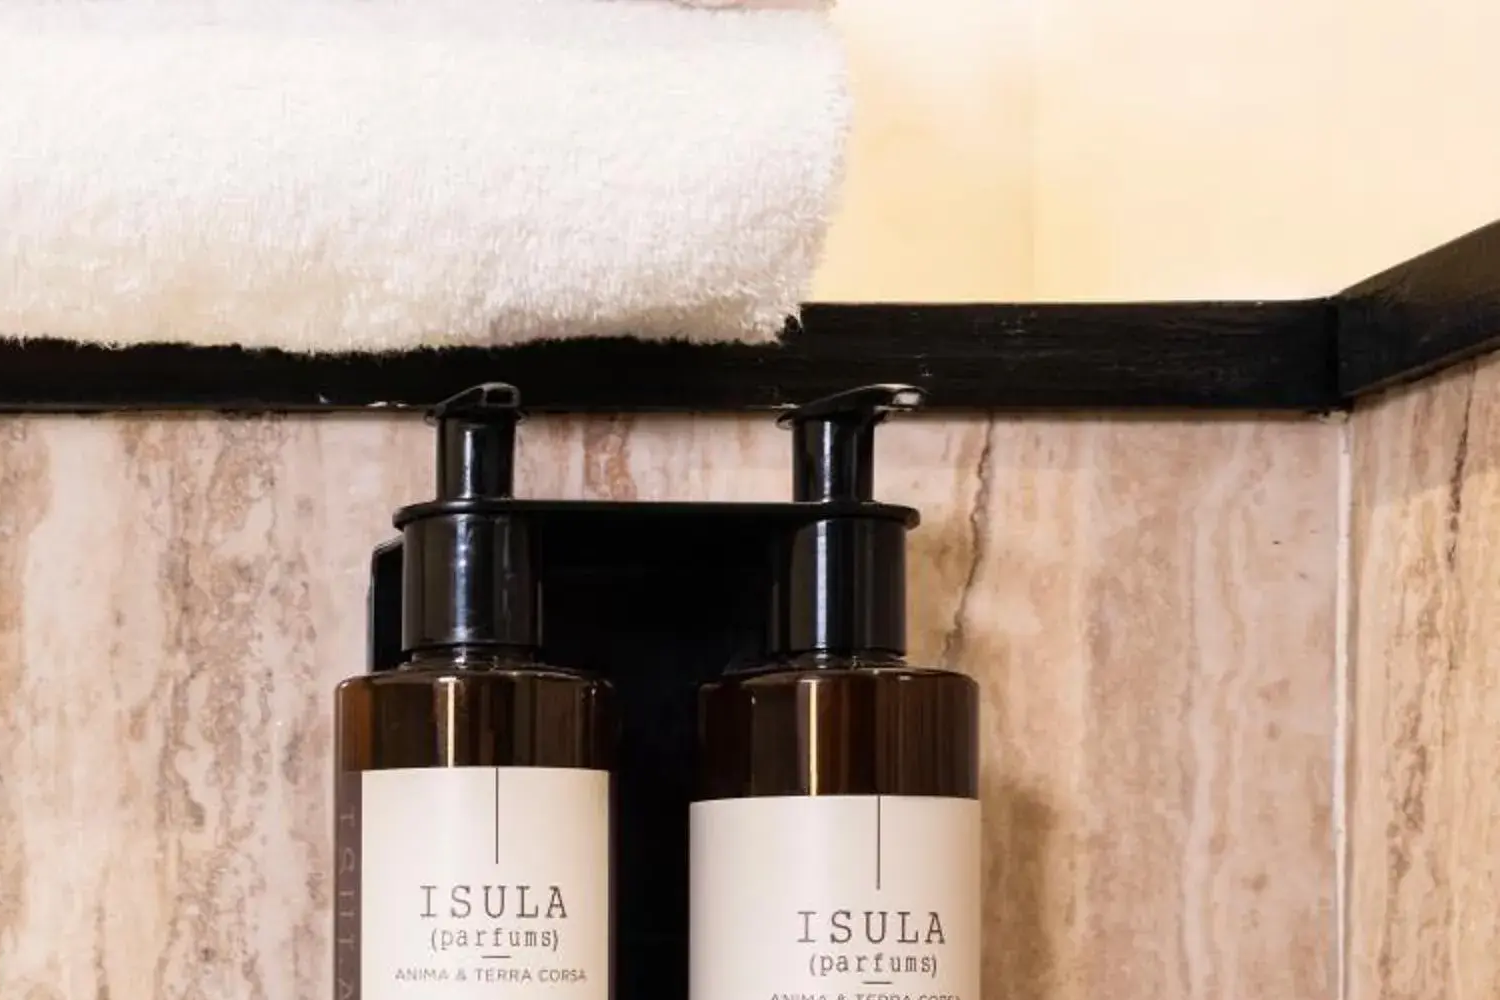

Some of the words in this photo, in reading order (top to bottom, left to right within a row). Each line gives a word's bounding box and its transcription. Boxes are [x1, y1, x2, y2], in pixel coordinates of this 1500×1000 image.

[419, 885, 568, 918] ISULA
[796, 910, 946, 944] ISULA
[431, 928, 560, 952] (parfums)
[394, 967, 449, 981] ANIMA
[456, 967, 467, 981] &
[475, 967, 532, 982] TERRA
[538, 967, 588, 983] CORSA
[809, 953, 938, 978] (parfums)
